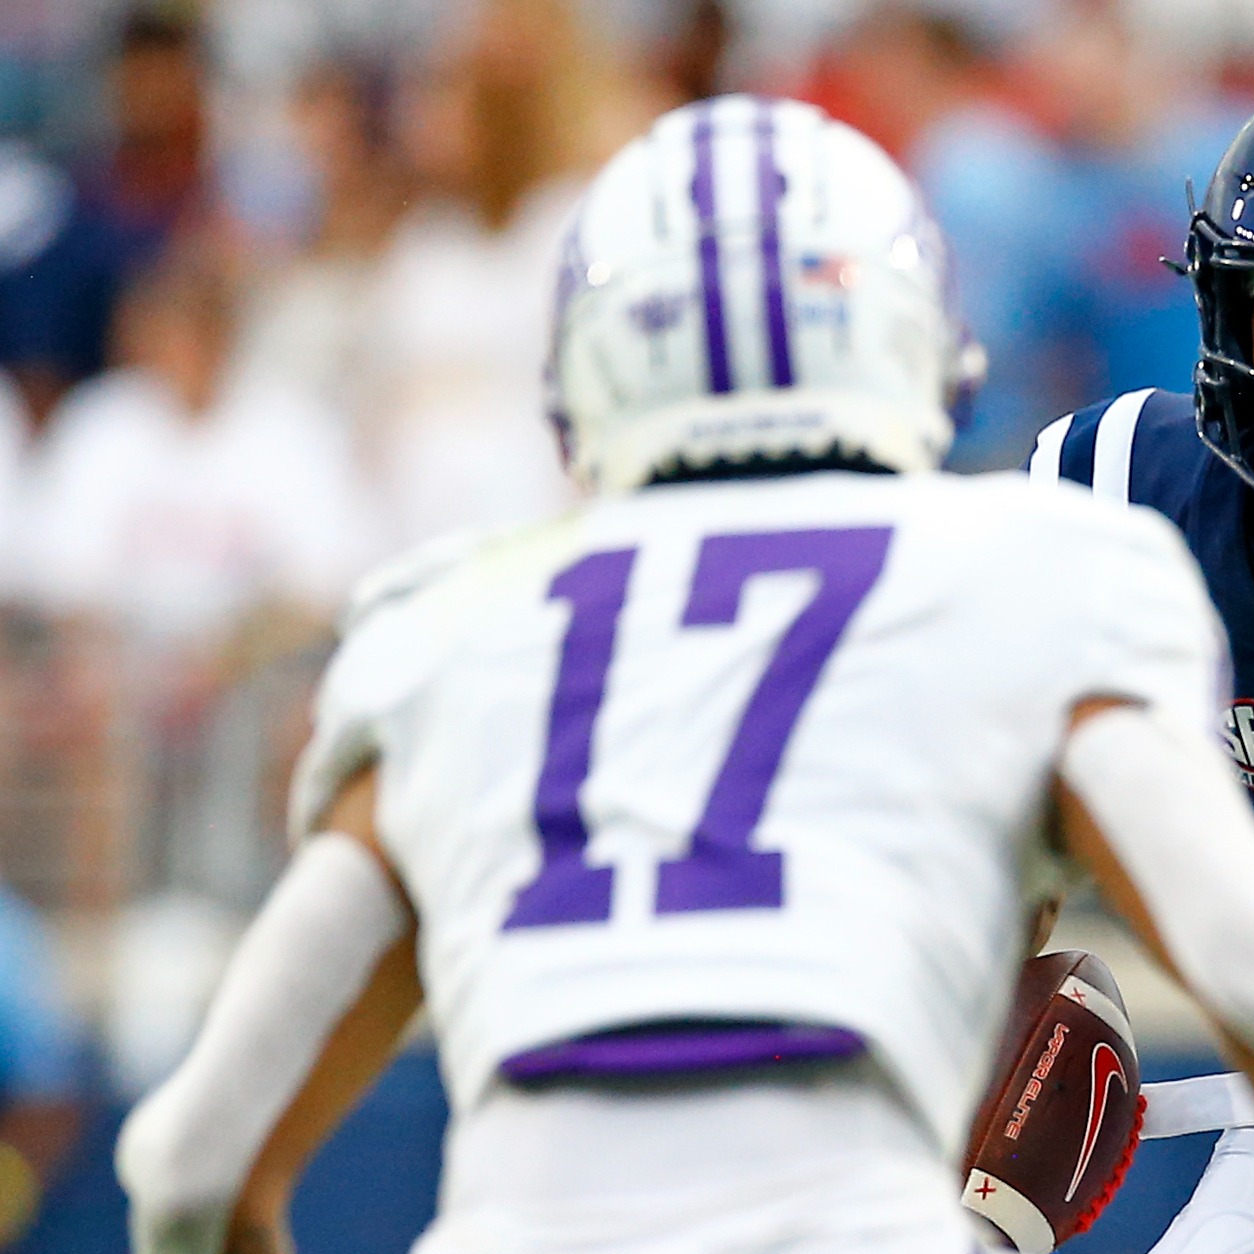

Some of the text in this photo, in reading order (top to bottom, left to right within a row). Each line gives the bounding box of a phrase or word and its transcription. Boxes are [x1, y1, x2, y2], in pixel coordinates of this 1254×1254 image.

[501, 525, 896, 933] 17
[1004, 1022, 1070, 1140] VAPOR ELITE
